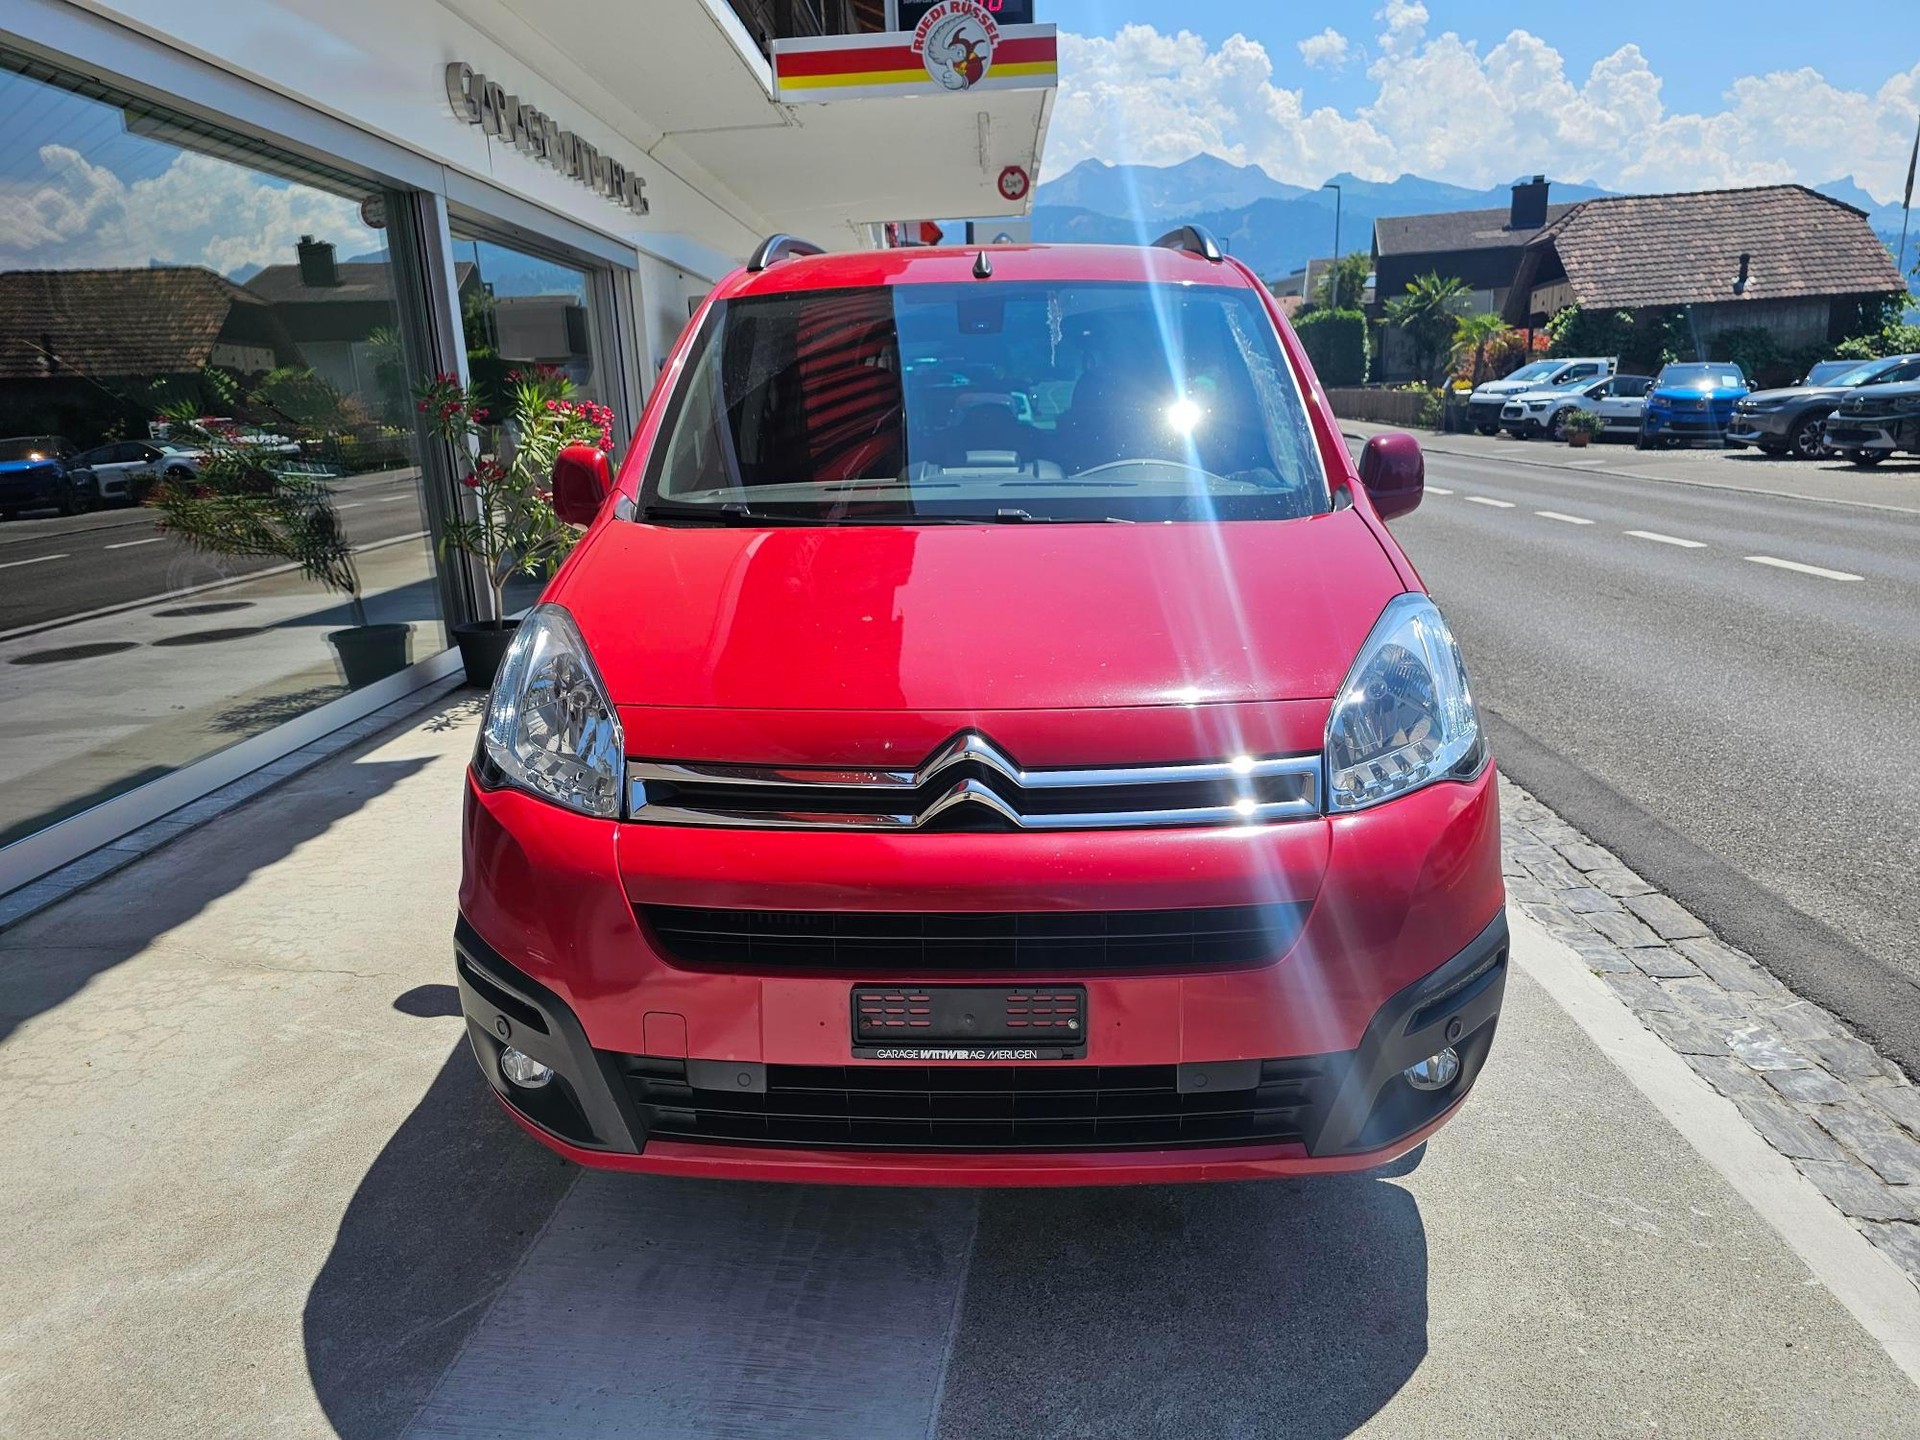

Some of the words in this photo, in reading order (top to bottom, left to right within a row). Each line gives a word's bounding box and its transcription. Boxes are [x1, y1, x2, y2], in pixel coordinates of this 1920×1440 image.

[913, 4, 947, 51] RUEDI
[876, 1049, 919, 1059] GARAGE
[920, 1049, 969, 1060] WITTWER
[969, 1050, 986, 1060] AG
